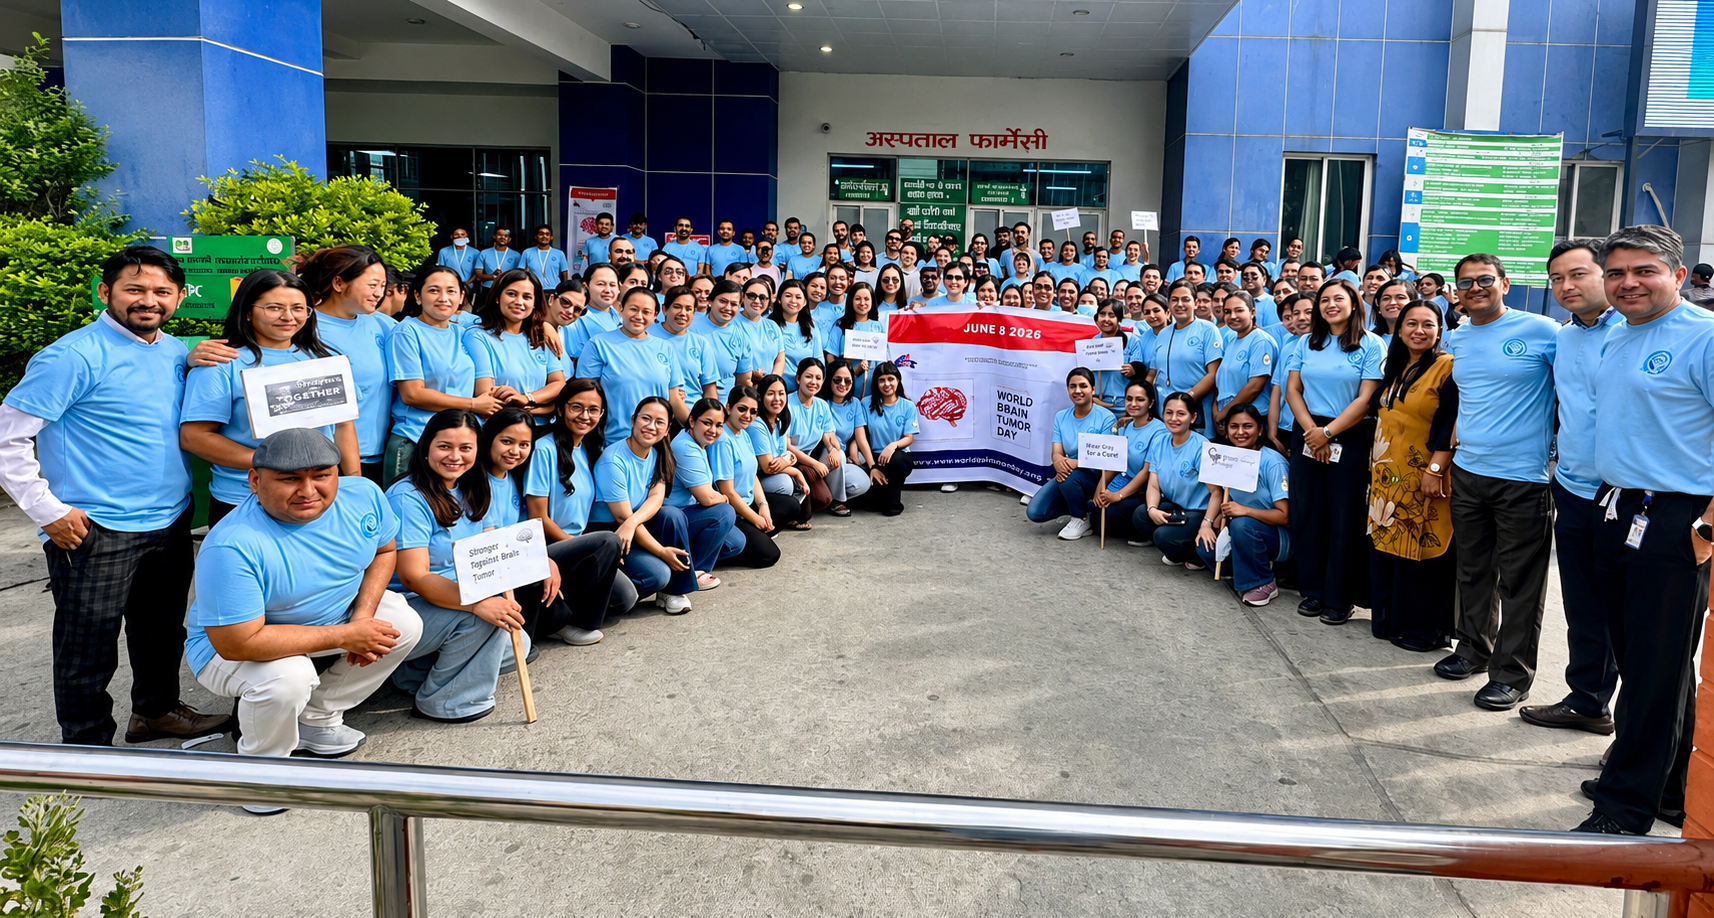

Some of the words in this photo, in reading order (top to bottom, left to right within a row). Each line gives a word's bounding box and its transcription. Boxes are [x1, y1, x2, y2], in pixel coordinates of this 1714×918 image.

[865, 131, 959, 148] अस्पताल
[963, 323, 996, 334] JUNE
[999, 325, 1006, 336] 8
[1008, 326, 1042, 340] 2026
[275, 386, 341, 404] TOGETHER
[997, 389, 1033, 407] WORLD
[997, 402, 1028, 420] BBAIN
[996, 414, 1031, 433] TUMOR
[997, 426, 1018, 440] DAY
